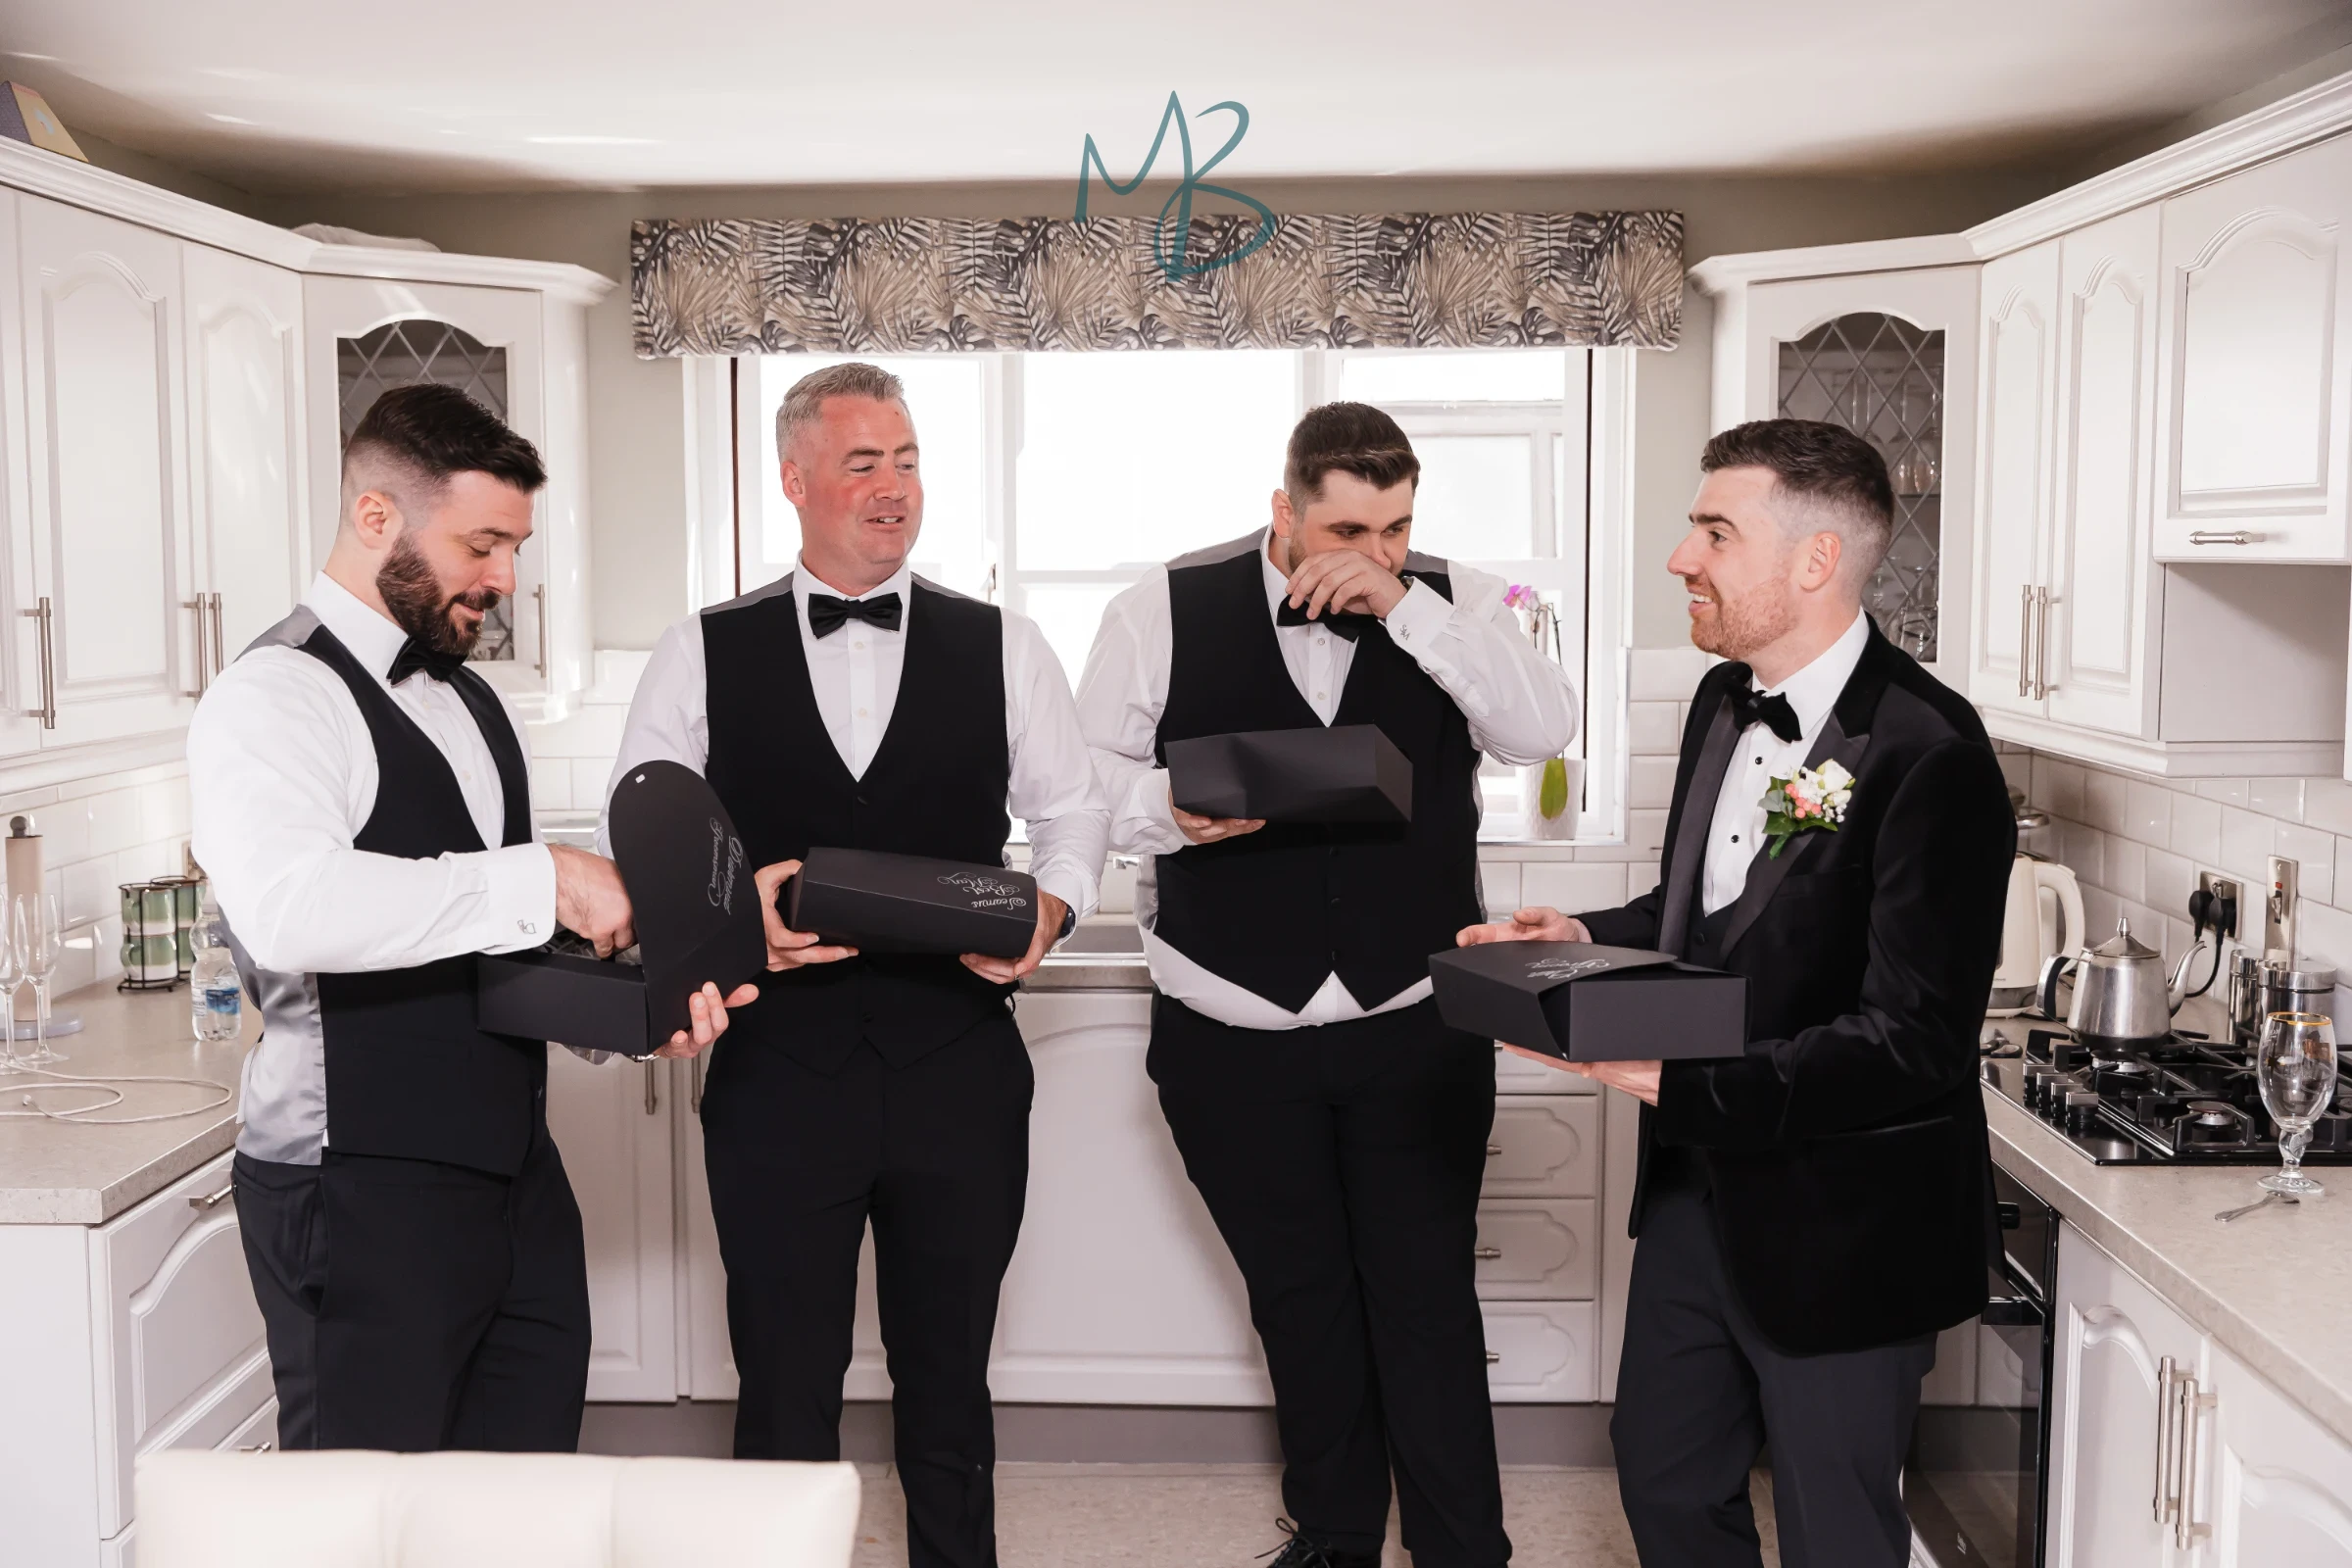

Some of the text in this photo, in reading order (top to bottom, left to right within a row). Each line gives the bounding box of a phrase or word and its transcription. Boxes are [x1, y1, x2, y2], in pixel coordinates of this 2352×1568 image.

[709, 816, 726, 906] Groomsman
[723, 835, 744, 915] Diarmuid
[937, 871, 999, 888] Man
[962, 883, 1020, 897] Best
[970, 897, 1027, 910] Seamus
